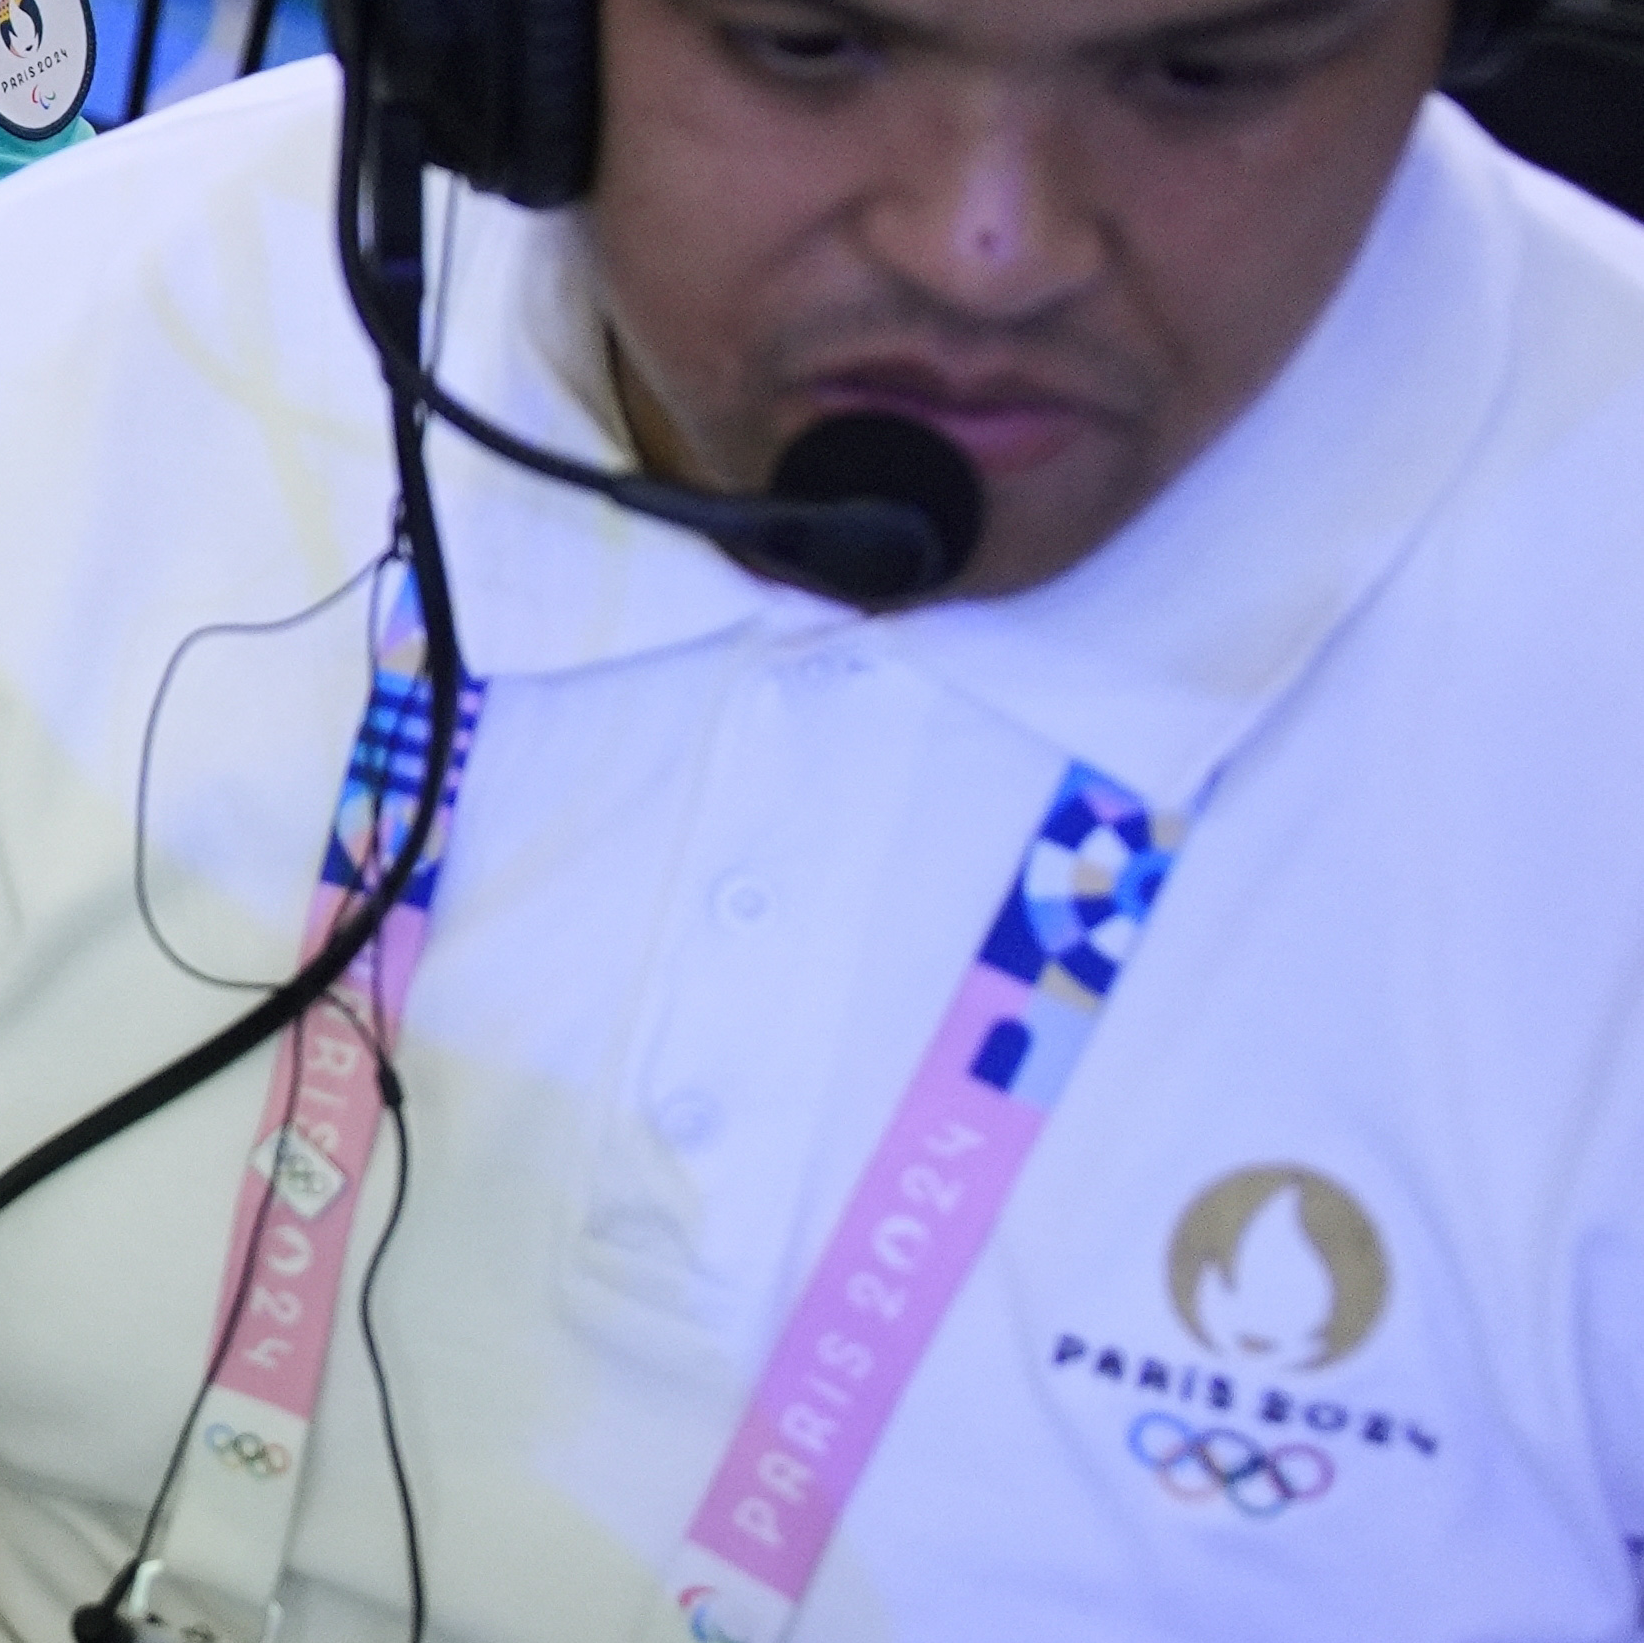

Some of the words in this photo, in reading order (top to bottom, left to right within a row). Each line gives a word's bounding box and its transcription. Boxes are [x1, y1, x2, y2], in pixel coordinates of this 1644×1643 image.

[37, 48, 70, 74] 2024
[732, 1328, 875, 1548] PARIS
[845, 1121, 987, 1323] 2024
